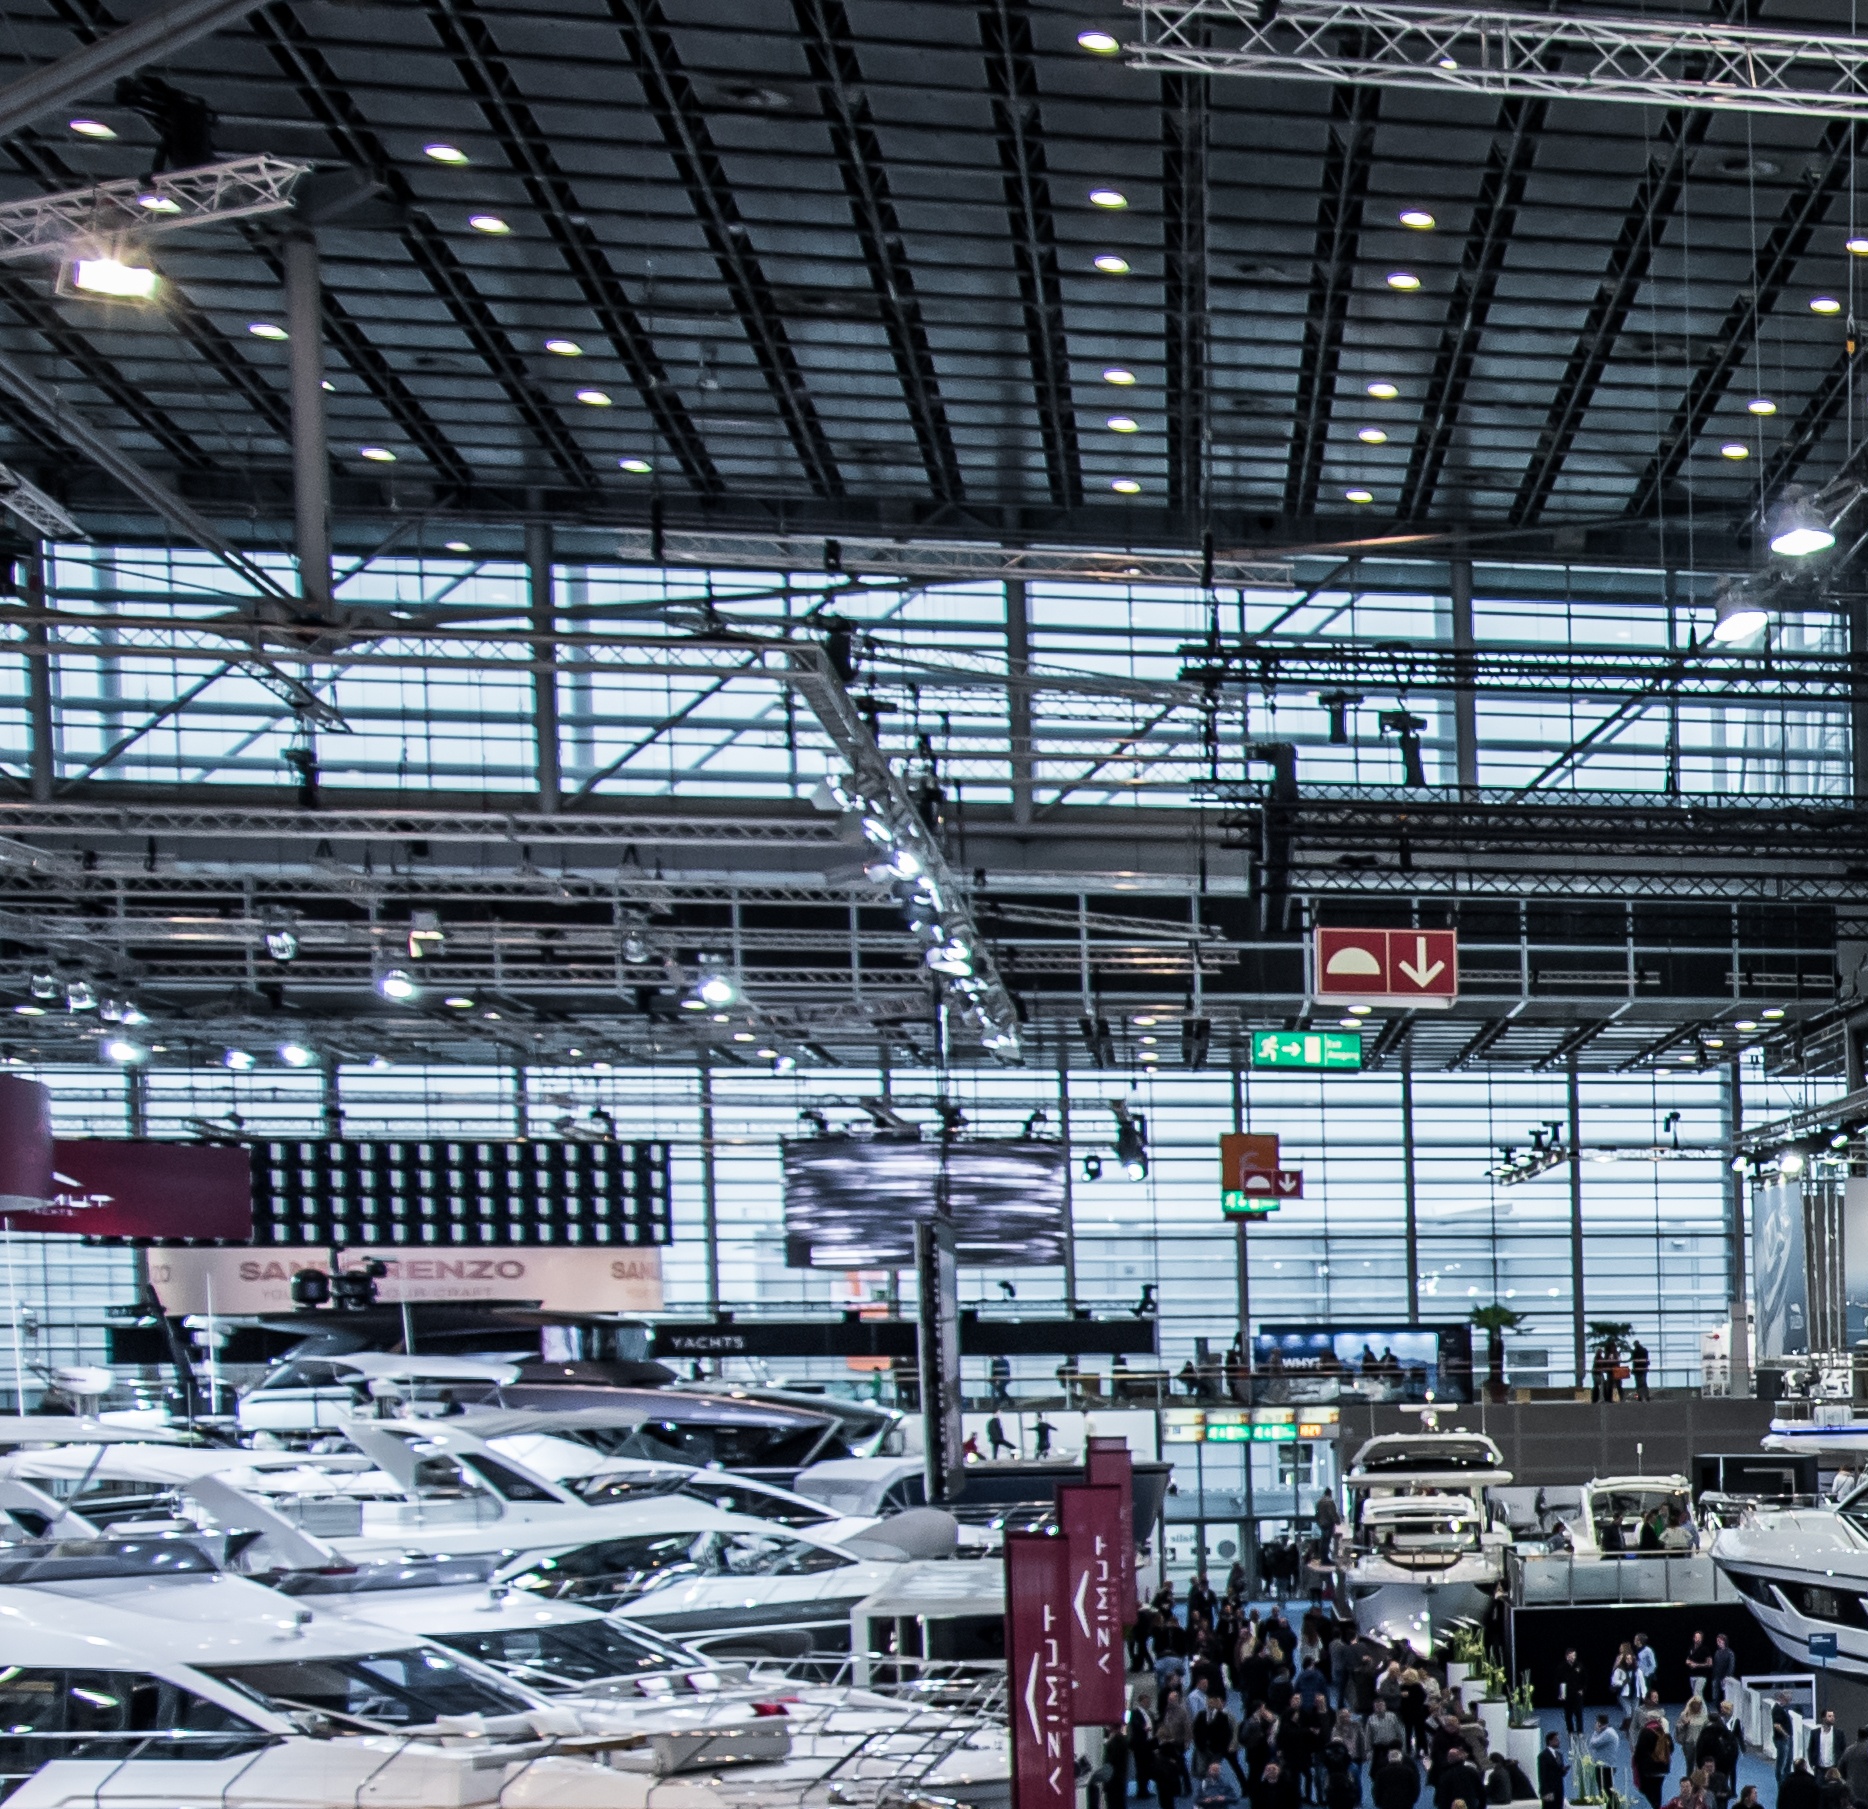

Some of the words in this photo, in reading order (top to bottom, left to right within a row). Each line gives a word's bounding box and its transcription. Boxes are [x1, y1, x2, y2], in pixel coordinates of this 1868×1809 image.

[671, 1336, 745, 1350] YACHTS
[1096, 1535, 1111, 1674] AZIMUT
[1043, 1604, 1062, 1795] AZIMUT
